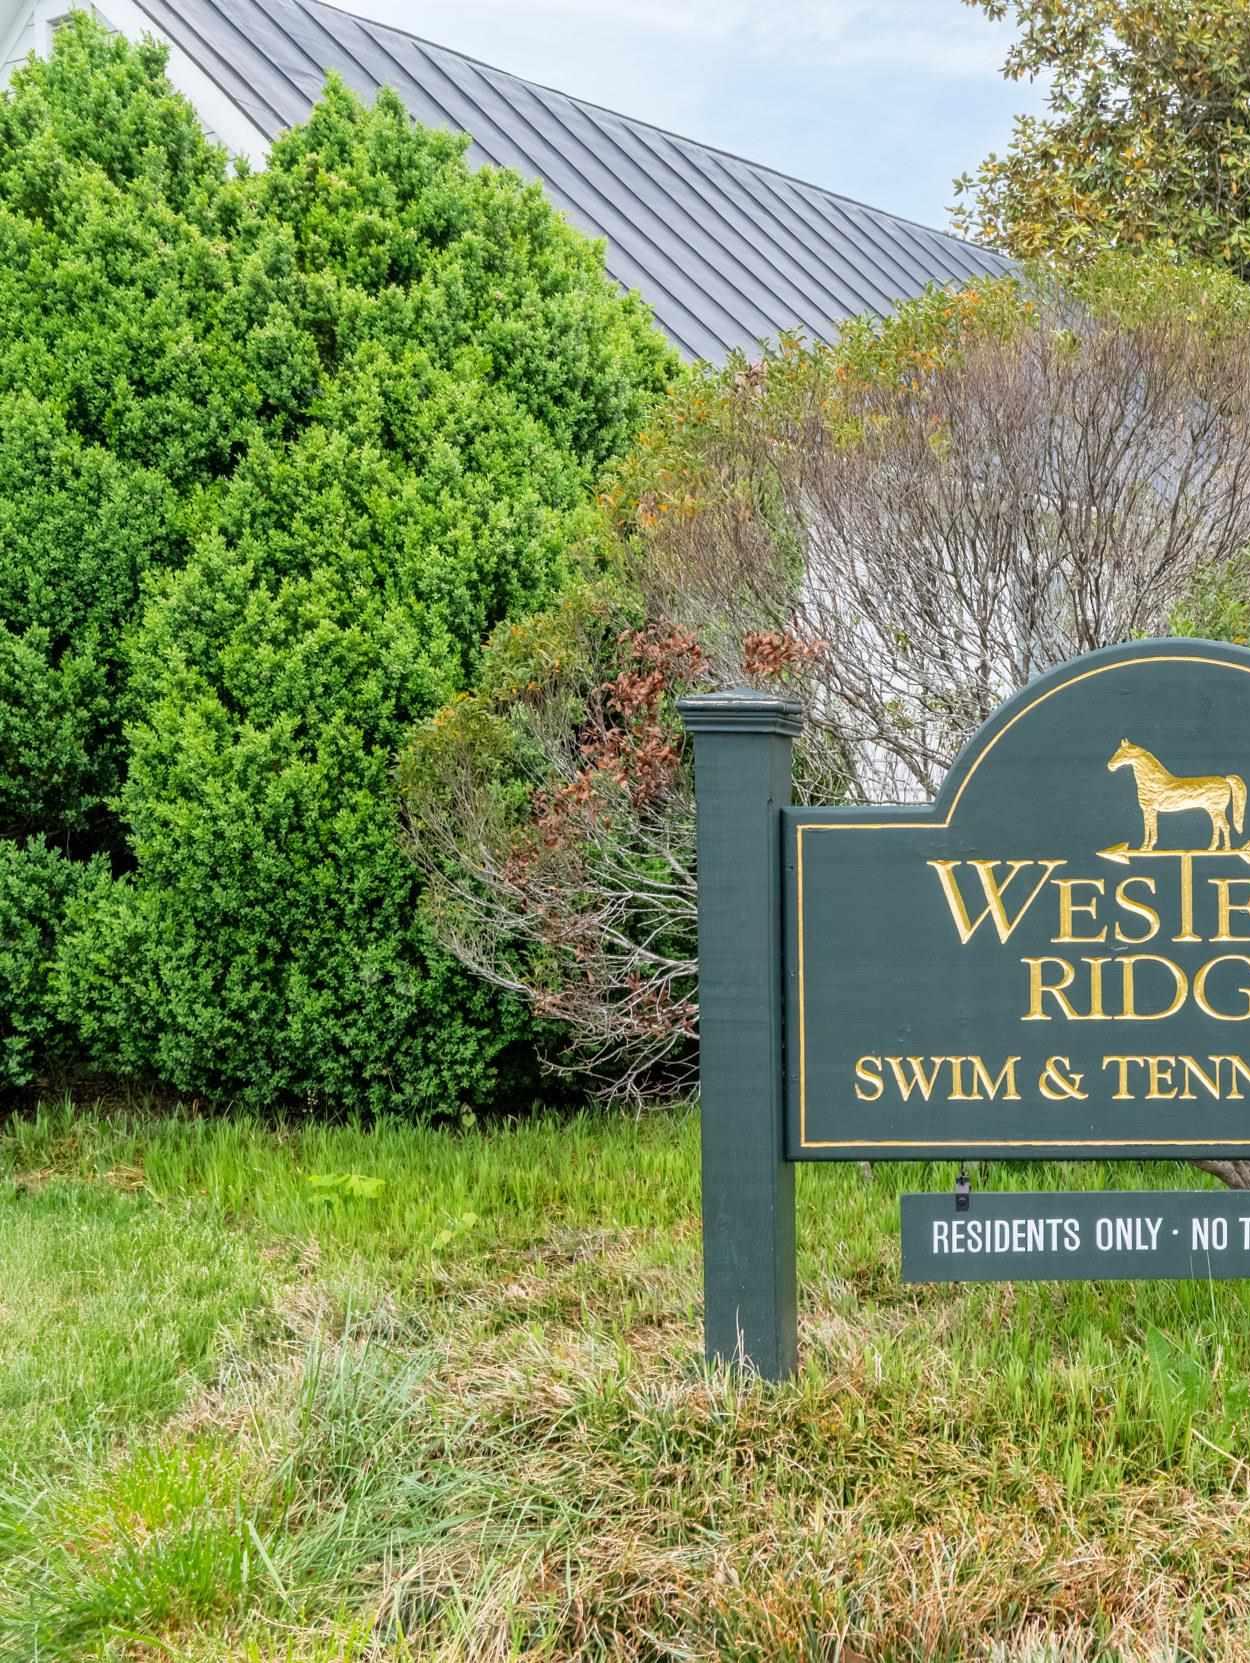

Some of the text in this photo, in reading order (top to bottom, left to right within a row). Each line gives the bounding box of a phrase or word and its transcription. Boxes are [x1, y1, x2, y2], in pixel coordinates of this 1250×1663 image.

[854, 1055, 1022, 1102] SWIM
[1038, 1055, 1090, 1102] &
[932, 1218, 1081, 1254] RESIDENTS
[1095, 1217, 1163, 1251] ONLY
[1191, 1217, 1228, 1251] NO
